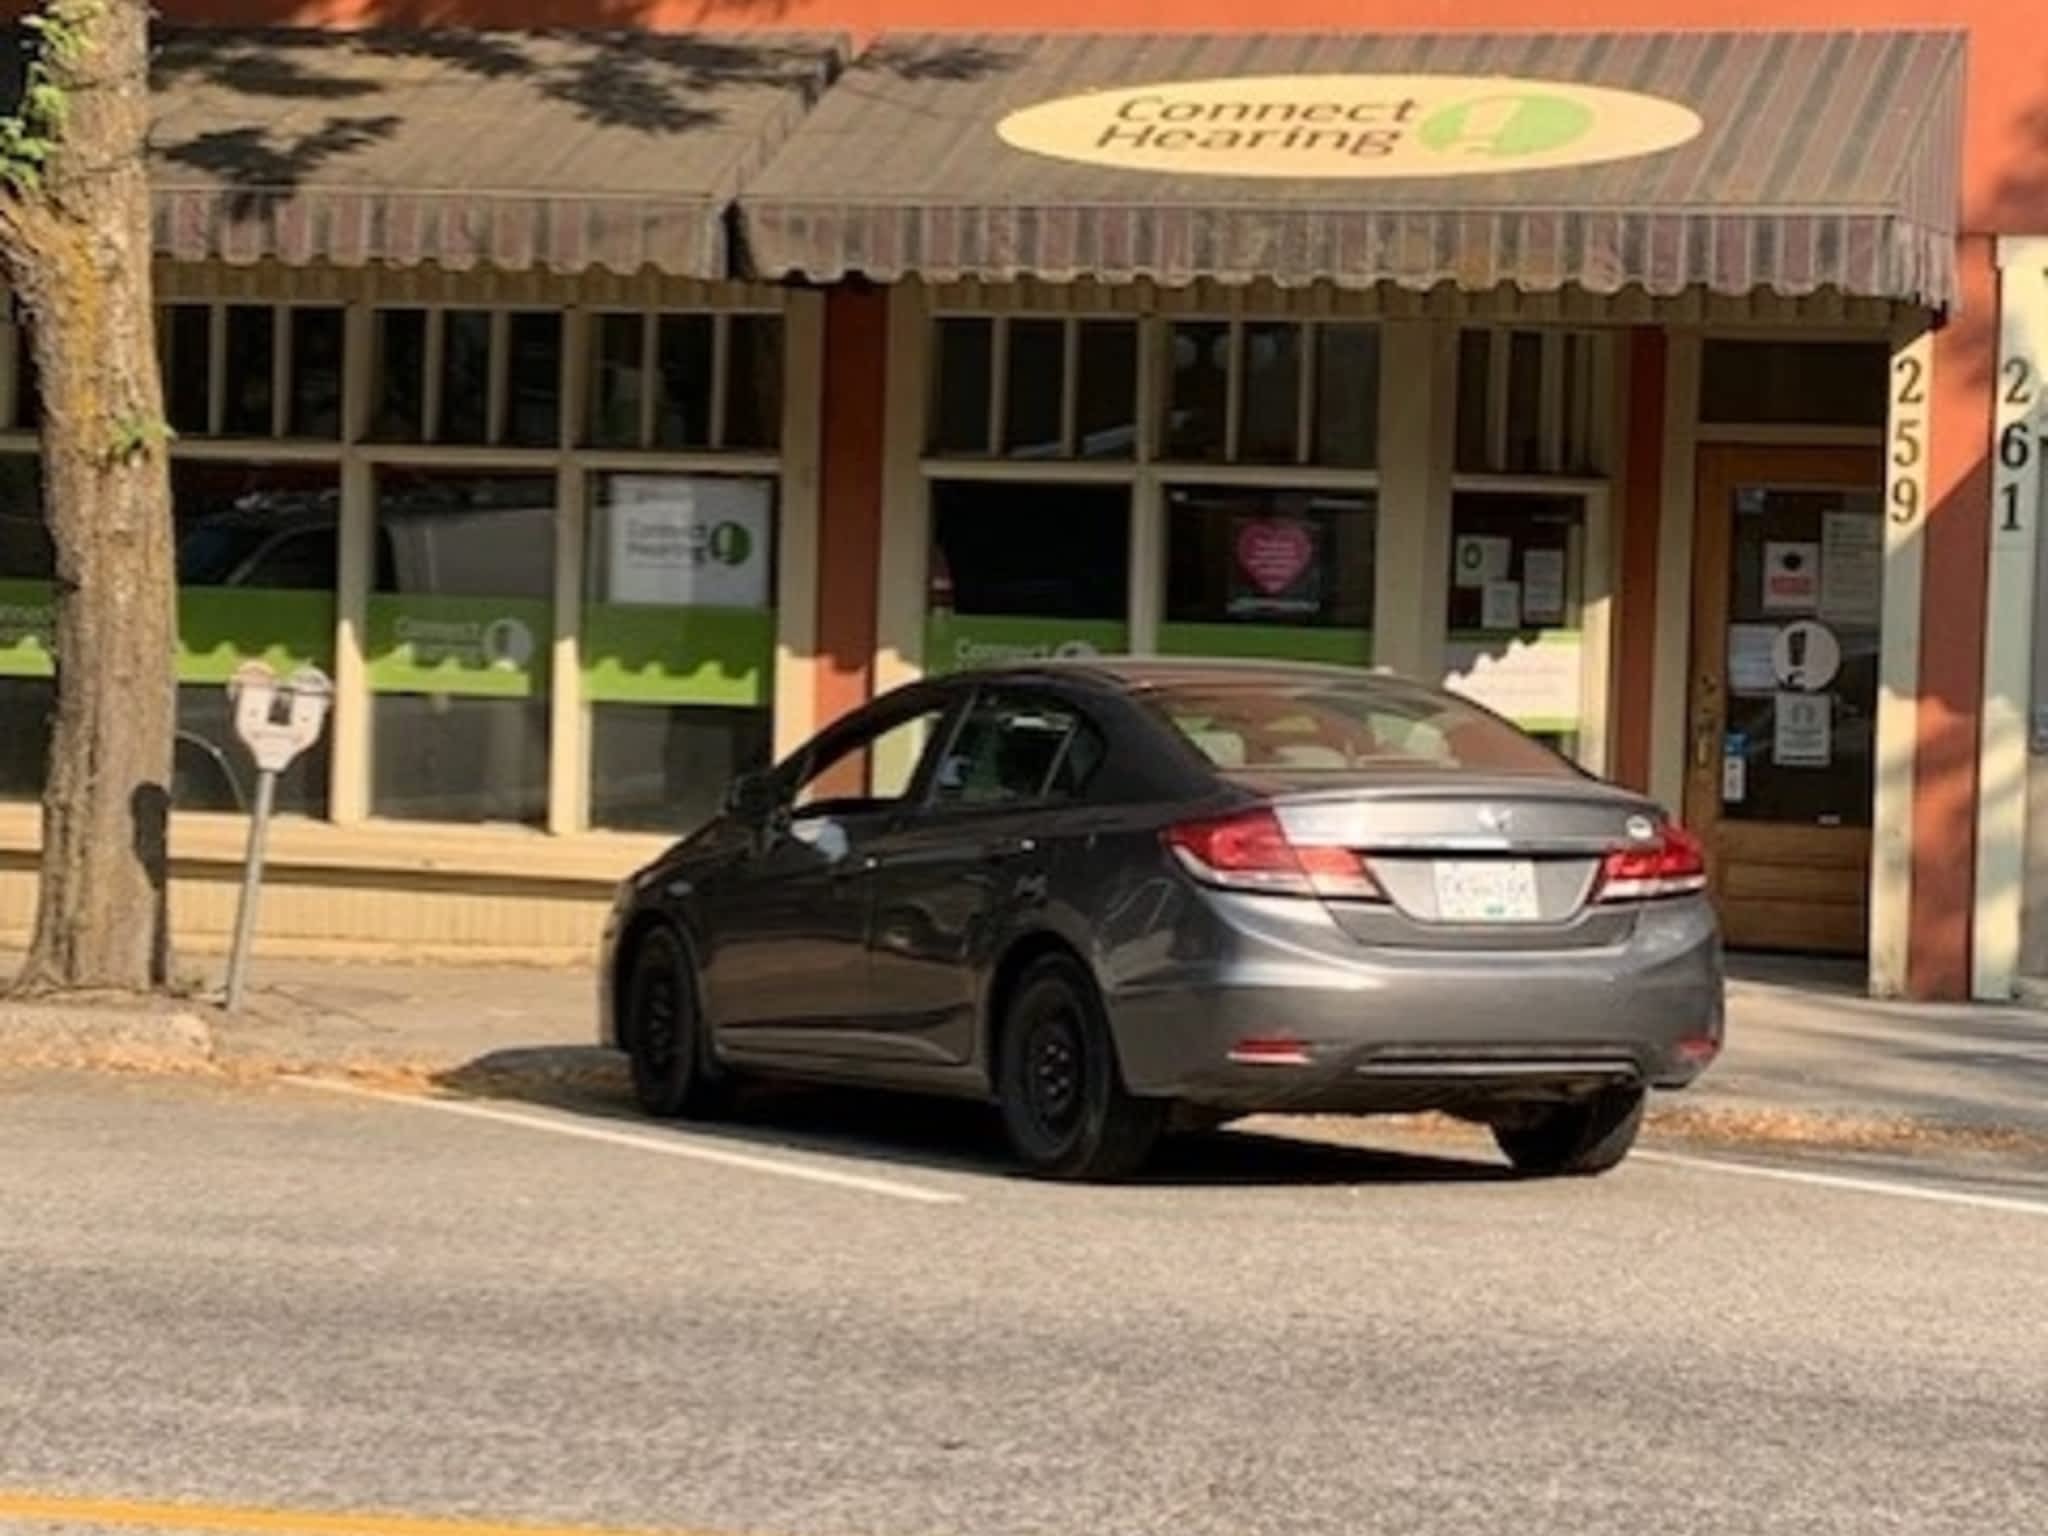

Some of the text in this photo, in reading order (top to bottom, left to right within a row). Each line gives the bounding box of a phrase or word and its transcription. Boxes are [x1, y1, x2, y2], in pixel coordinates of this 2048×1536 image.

[1096, 124, 1401, 157] Hearing
[1117, 96, 1414, 123] Connect
[1890, 357, 1924, 525] 259
[2000, 357, 2032, 531] 261
